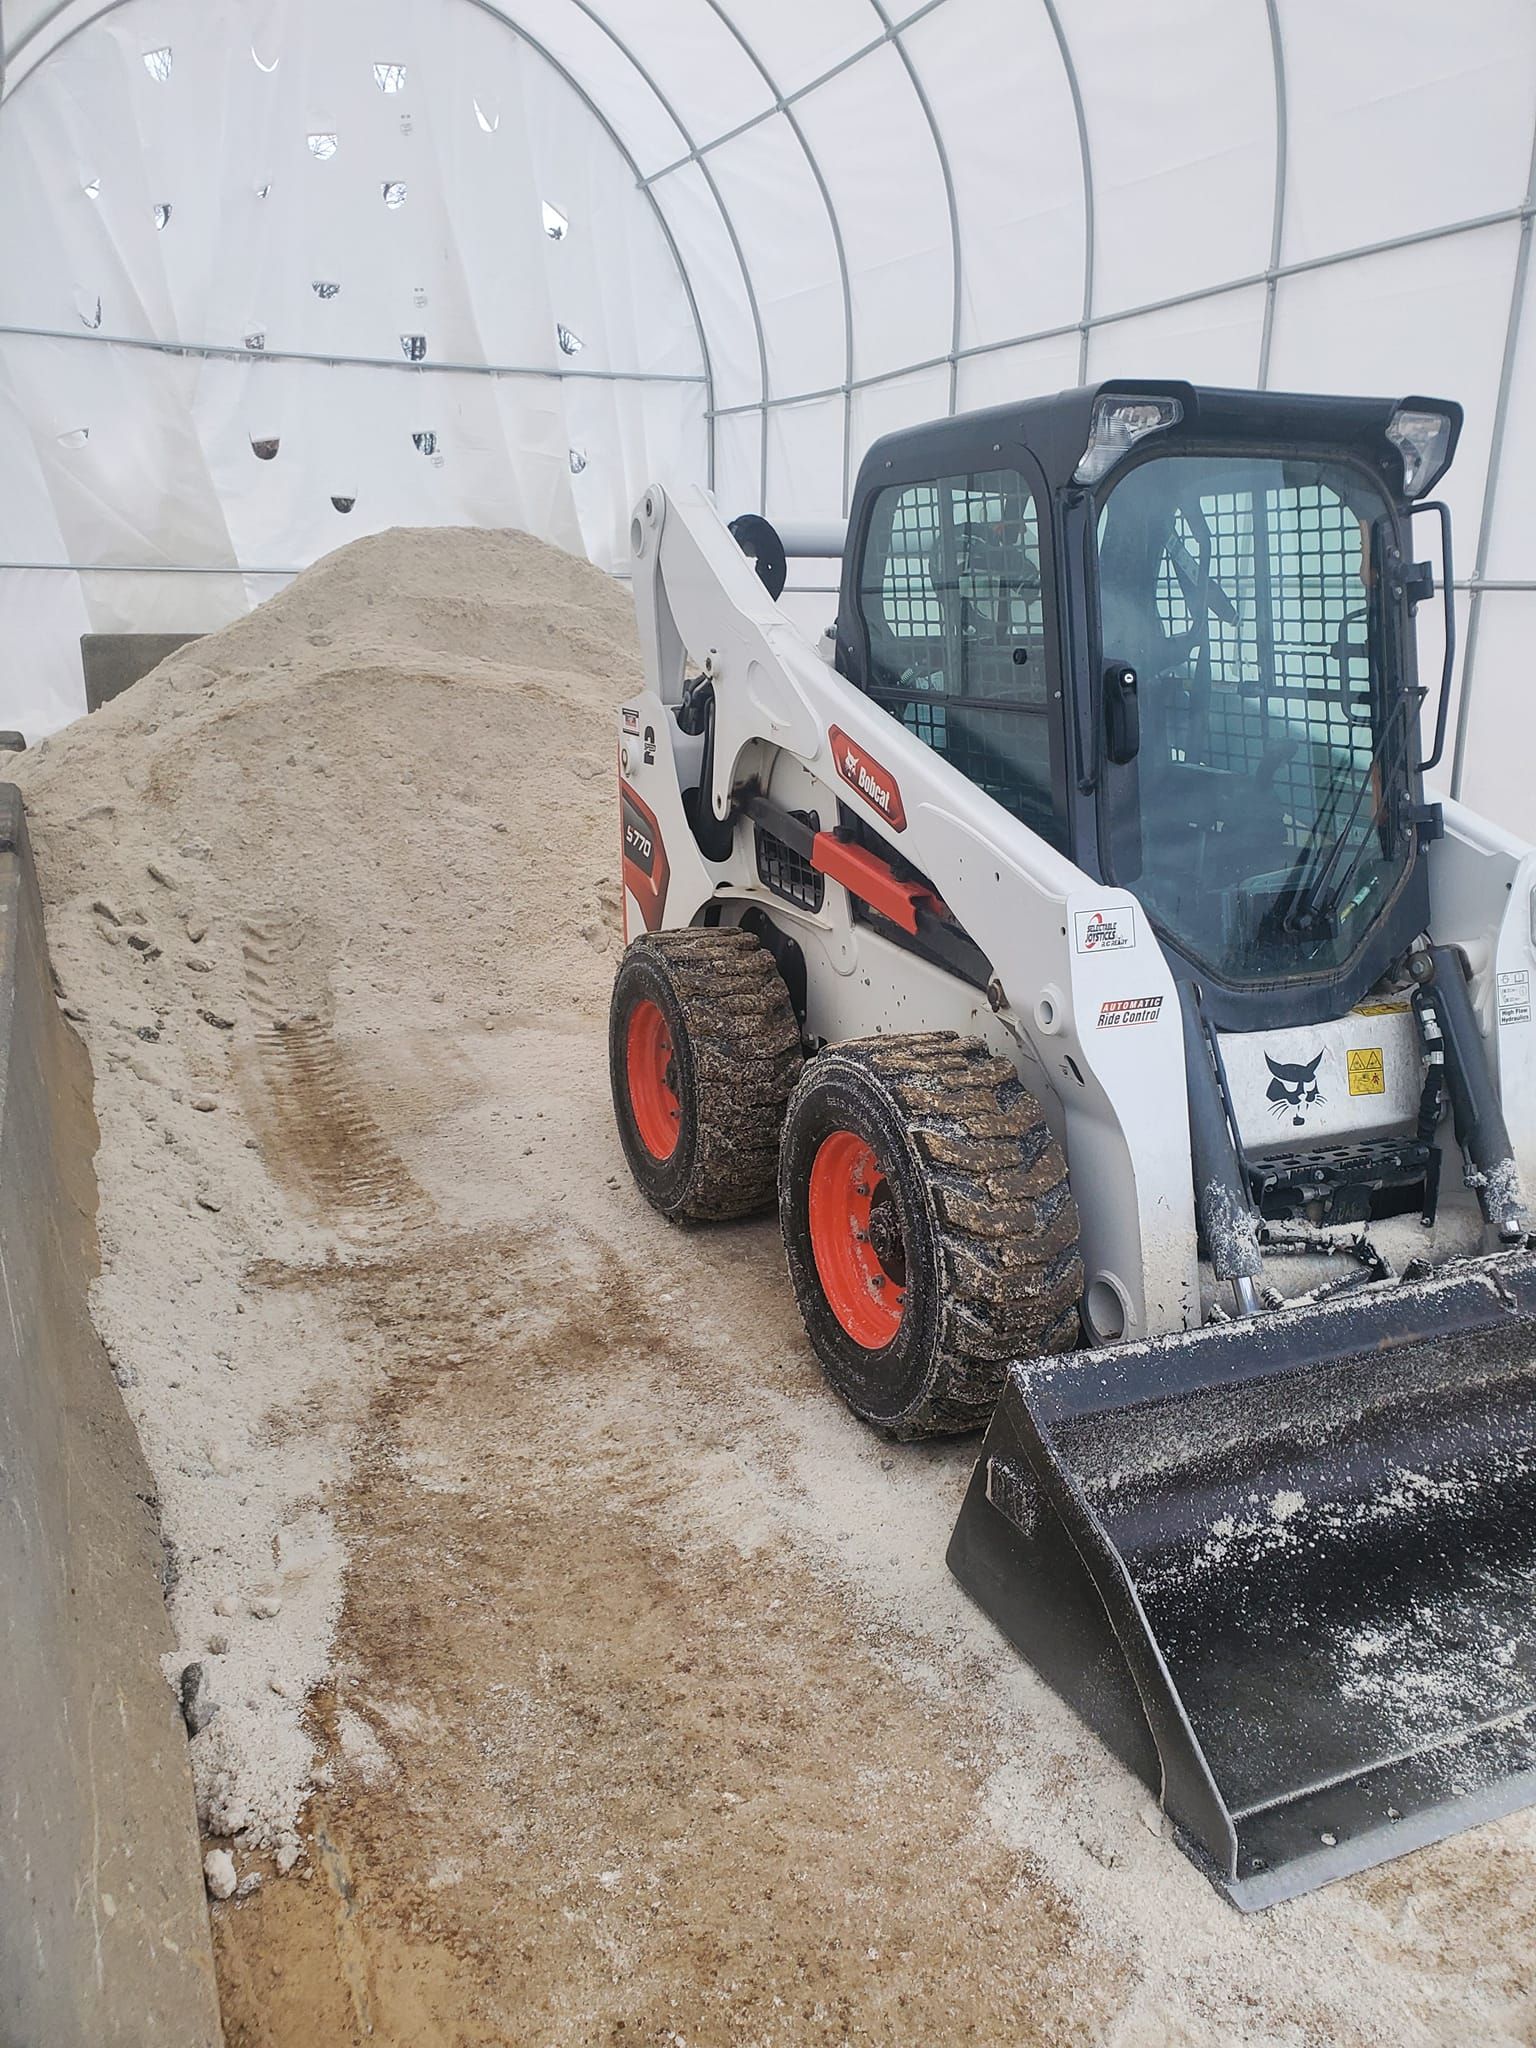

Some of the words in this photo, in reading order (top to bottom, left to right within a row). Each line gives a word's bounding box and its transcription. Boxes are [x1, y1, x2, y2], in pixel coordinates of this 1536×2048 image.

[858, 766, 890, 812] Bobcat
[626, 825, 651, 857] S770
[1085, 930, 1116, 943] JOYSTICKS
[1102, 998, 1160, 1012] AUTOMATIC
[1097, 1013, 1121, 1026] Ride
[1122, 1008, 1160, 1023] Control
